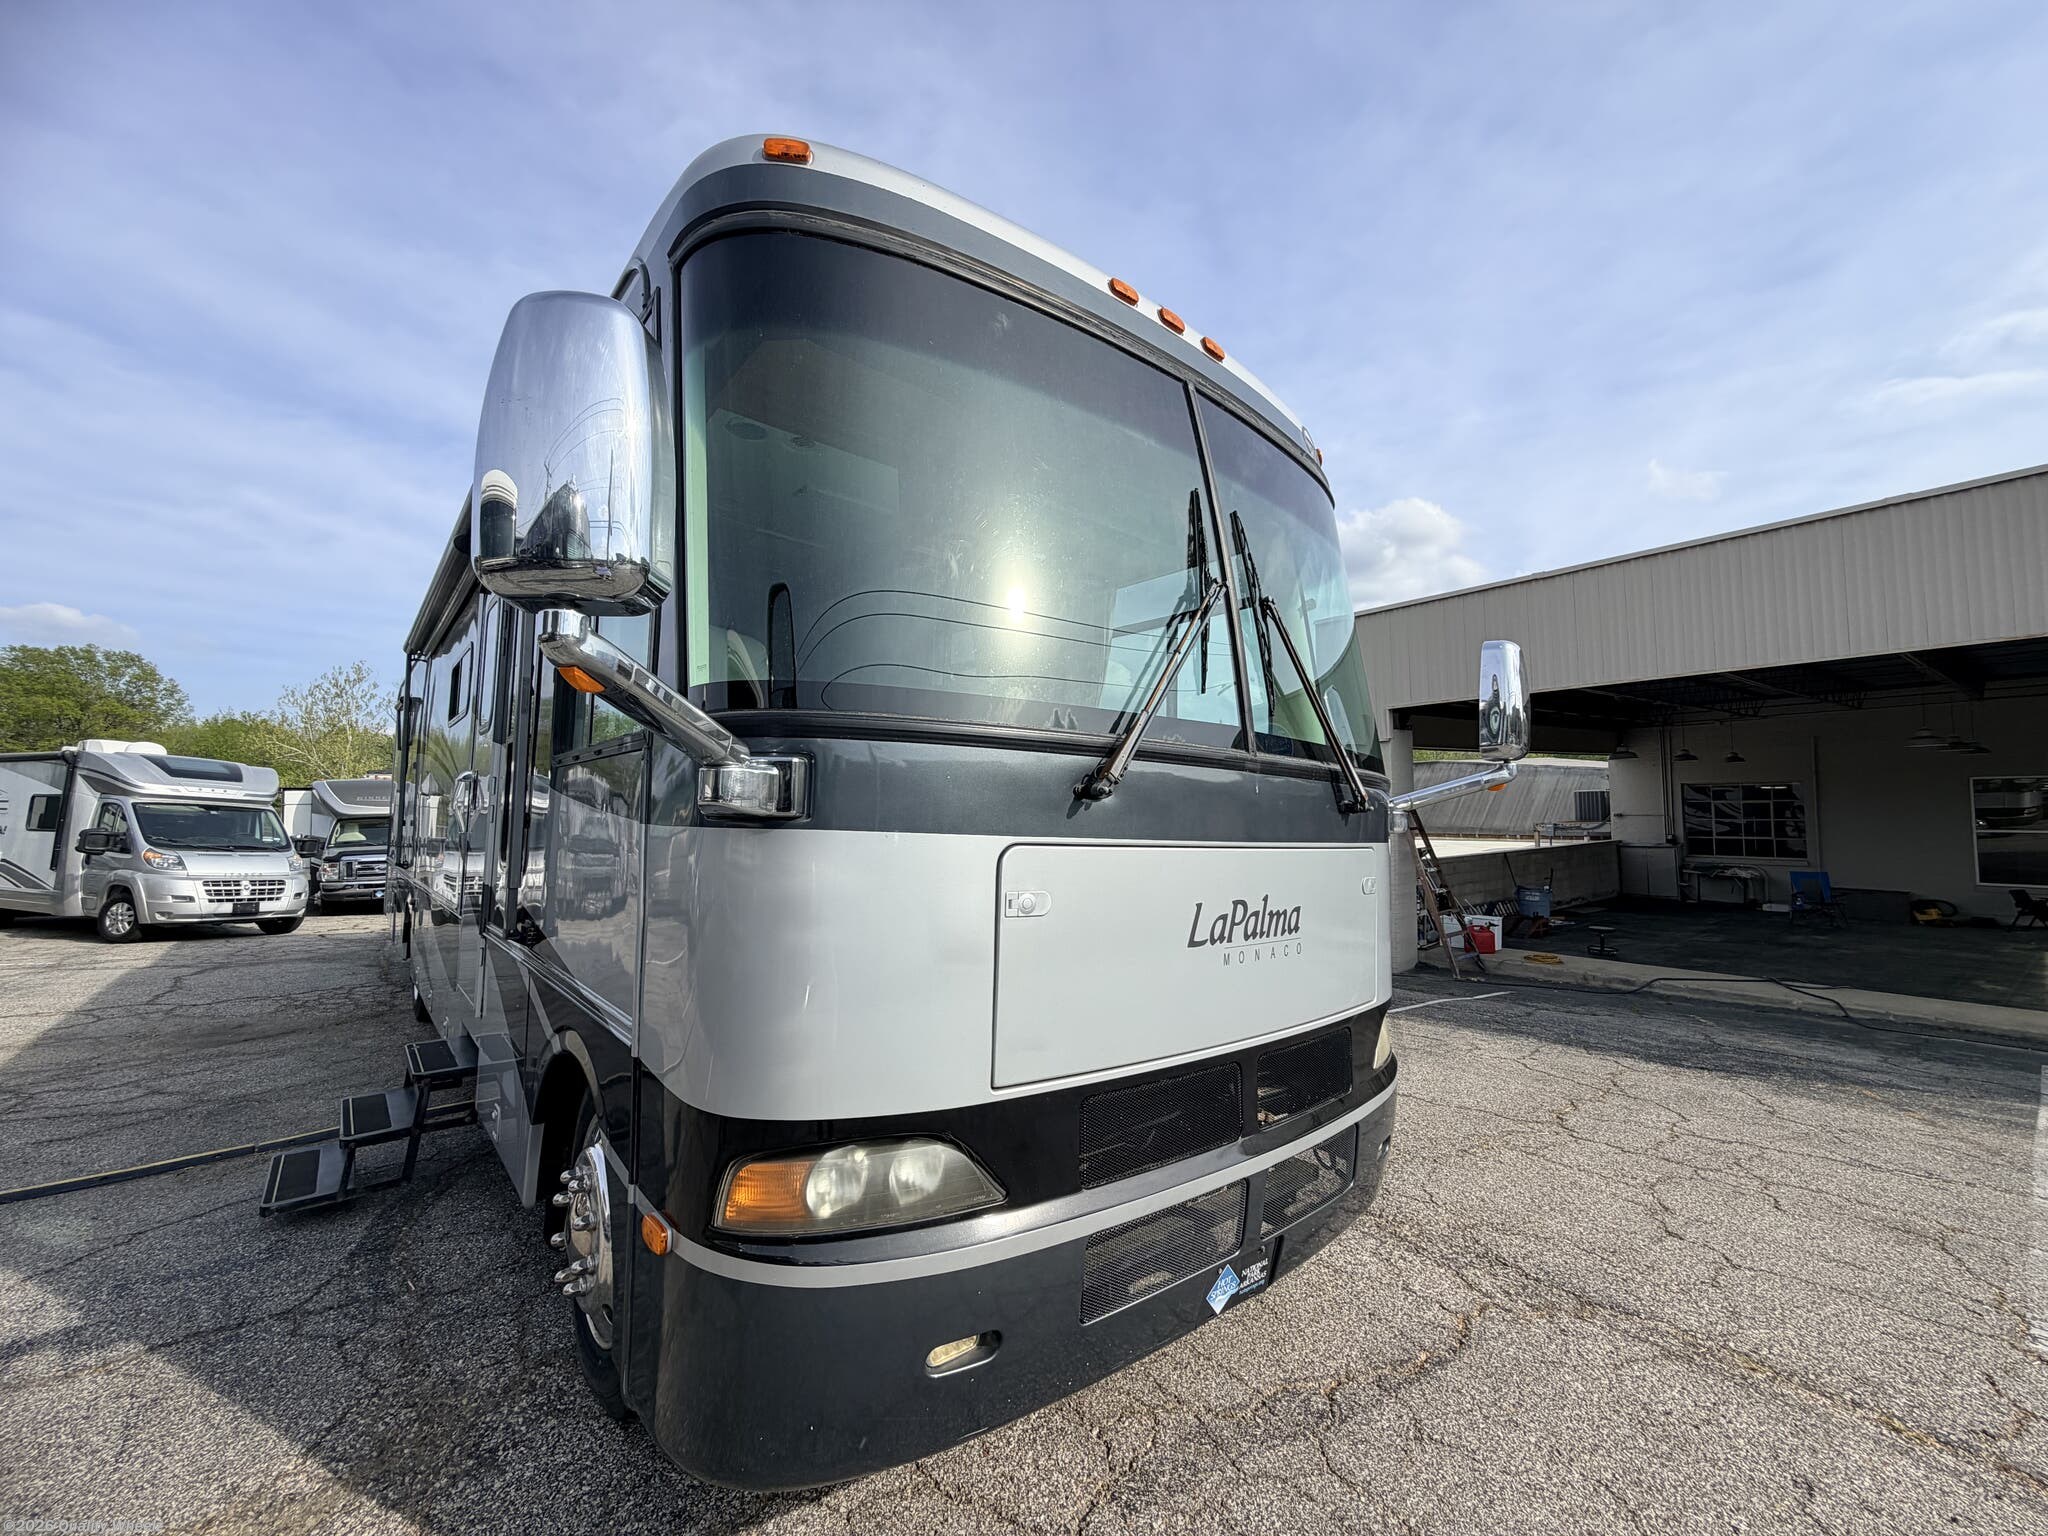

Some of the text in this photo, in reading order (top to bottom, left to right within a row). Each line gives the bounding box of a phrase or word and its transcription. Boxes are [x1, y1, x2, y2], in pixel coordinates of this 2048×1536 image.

[1187, 894, 1302, 948] LaPalma
[1223, 942, 1302, 966] MONACO
[1210, 1281, 1237, 1300] SPRINGS
[1217, 1275, 1233, 1290] HOT
